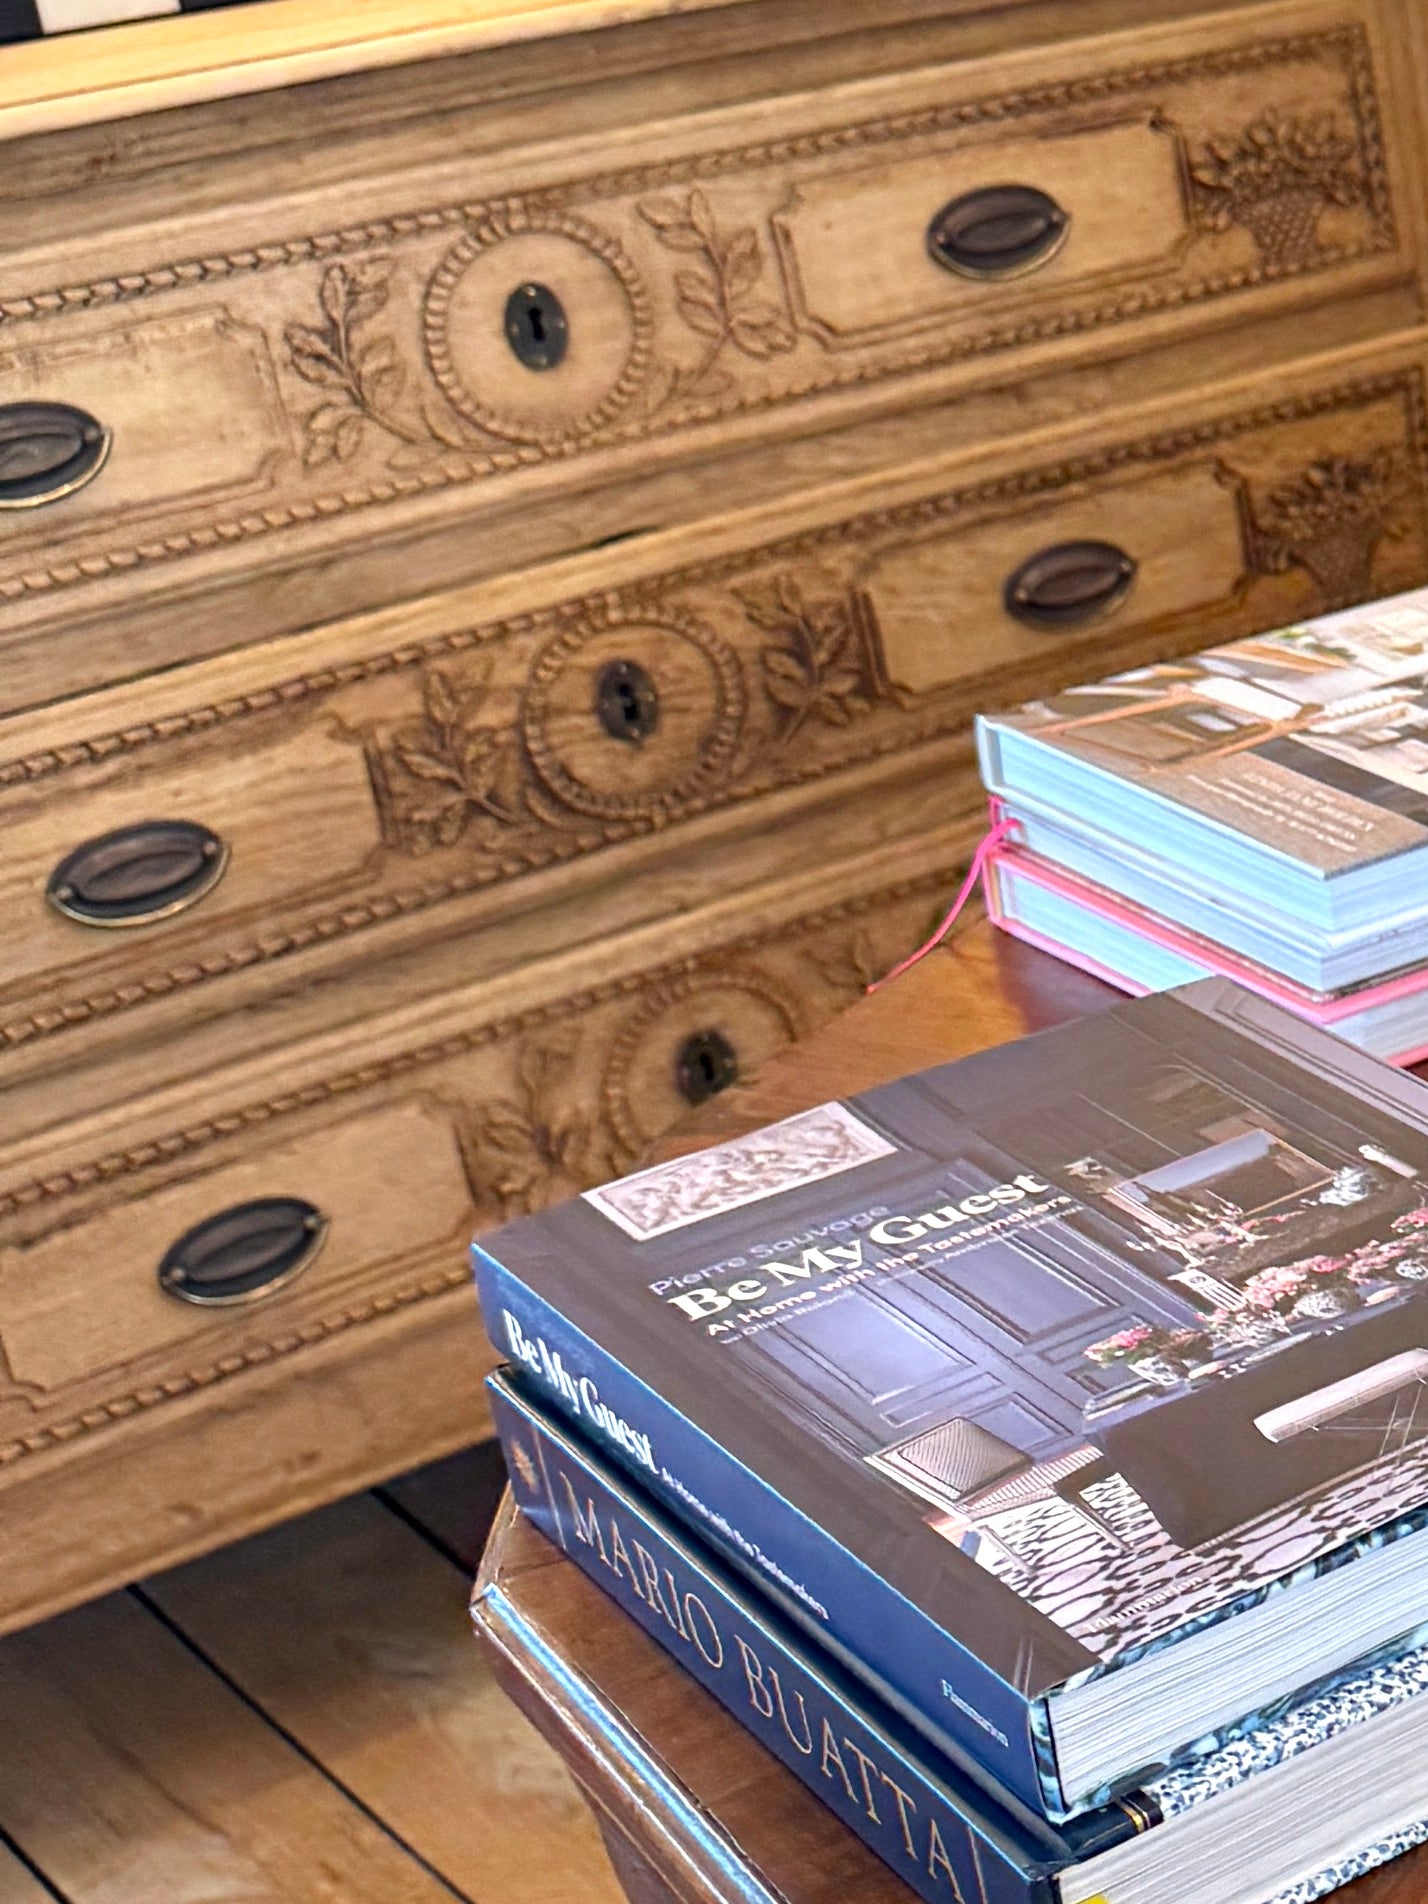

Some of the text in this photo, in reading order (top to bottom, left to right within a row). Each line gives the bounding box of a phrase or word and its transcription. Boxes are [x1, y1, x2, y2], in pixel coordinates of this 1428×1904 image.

[649, 1204, 891, 1296] Pierre Sauvage
[666, 1277, 768, 1323] Be
[757, 1237, 864, 1288] My
[868, 1172, 1051, 1246] Guest
[707, 1319, 737, 1337] At
[736, 1290, 817, 1324] Home
[818, 1267, 877, 1293] with
[876, 1249, 920, 1272] the
[917, 1194, 1072, 1254] Tastemakers
[502, 1307, 660, 1474] Be My Guest
[560, 1470, 724, 1670] MARIO
